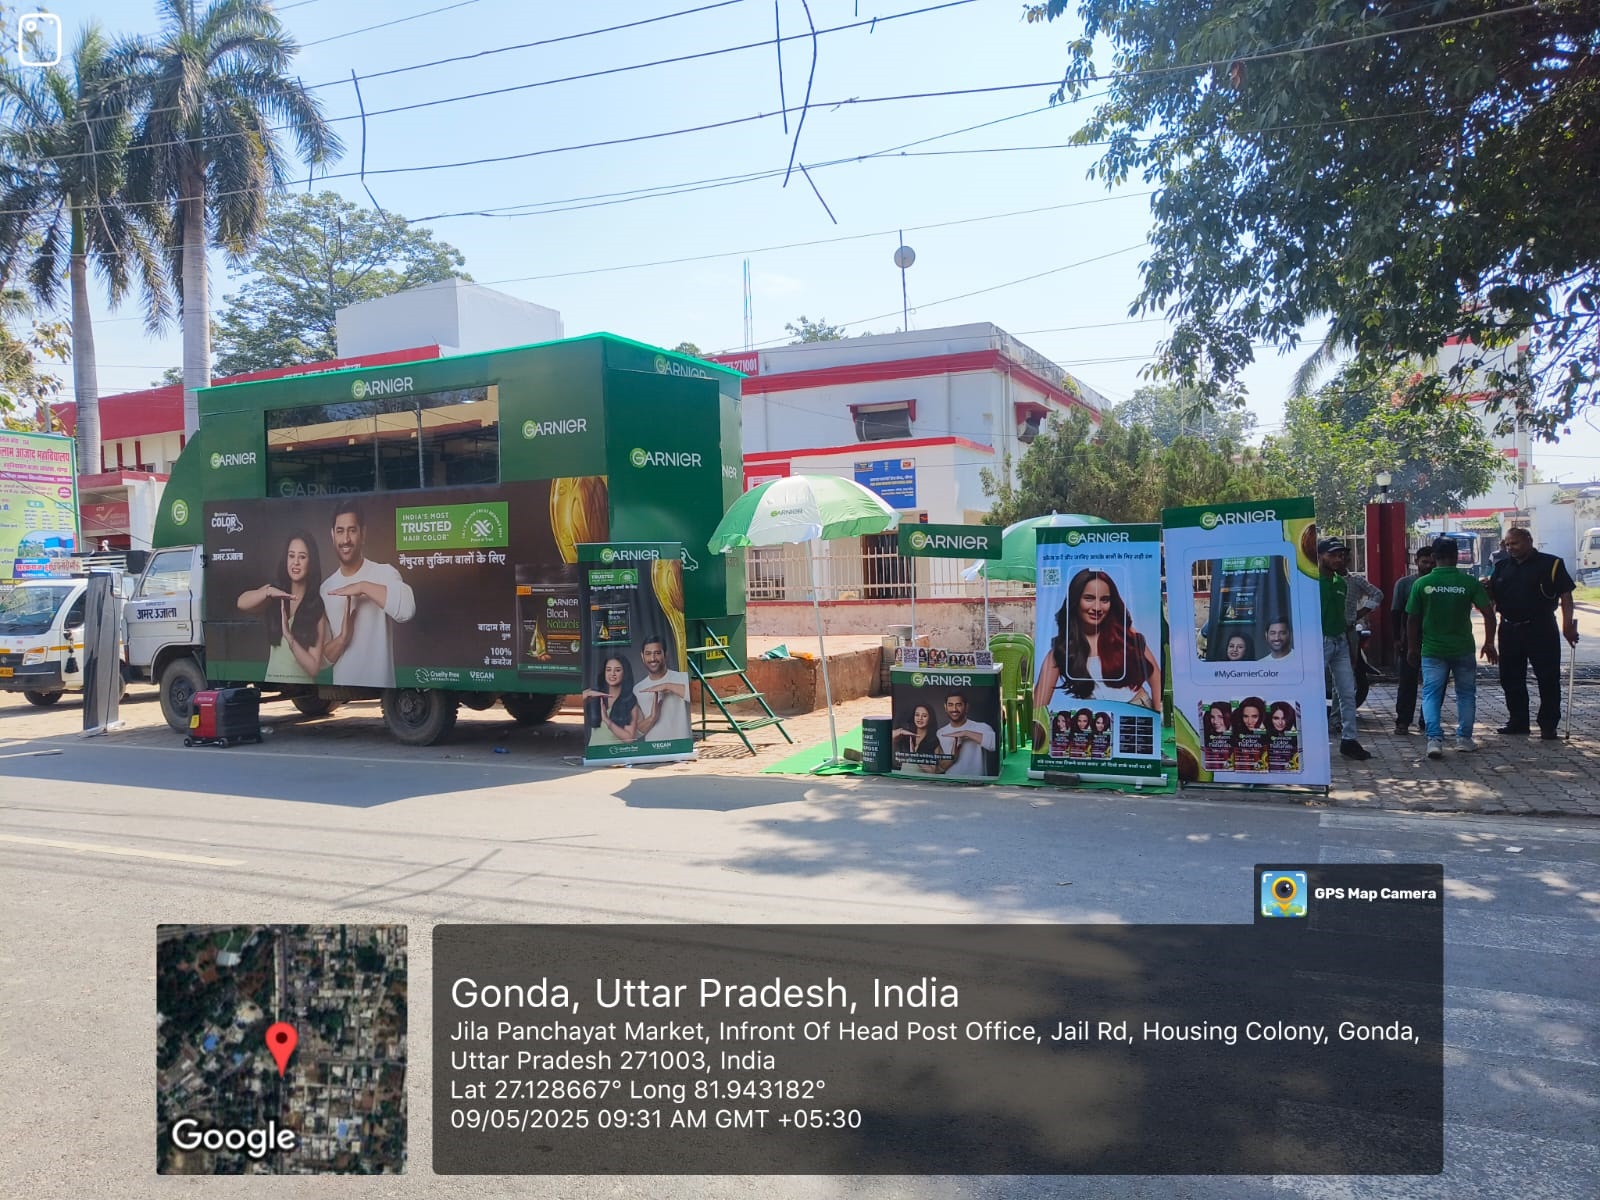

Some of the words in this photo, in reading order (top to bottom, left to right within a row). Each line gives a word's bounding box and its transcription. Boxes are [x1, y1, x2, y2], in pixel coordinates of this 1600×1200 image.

[352, 377, 413, 399] GARNIER
[522, 418, 587, 440] GARNIER
[210, 452, 256, 470] GARNIER
[630, 448, 702, 468] GARNIER
[211, 516, 236, 527] COLOR
[401, 520, 452, 533] TRUSTED
[1200, 510, 1276, 530] GARNIER
[909, 530, 988, 550] GARNIER
[1066, 530, 1130, 547] GARNIER
[399, 553, 424, 569] नैचुरल
[426, 552, 452, 568] लुकिंग
[476, 551, 486, 563] के
[488, 550, 506, 565] लिए
[600, 548, 659, 564] GARNIER
[1424, 585, 1466, 594] GARNIER
[547, 598, 578, 607] GARNIER
[547, 608, 568, 618] Black
[499, 621, 511, 631] तेल
[547, 620, 580, 628] Naturals
[491, 648, 512, 656] 100%
[912, 673, 971, 687] GARNIER
[1214, 669, 1279, 679] #MyGarnierColor
